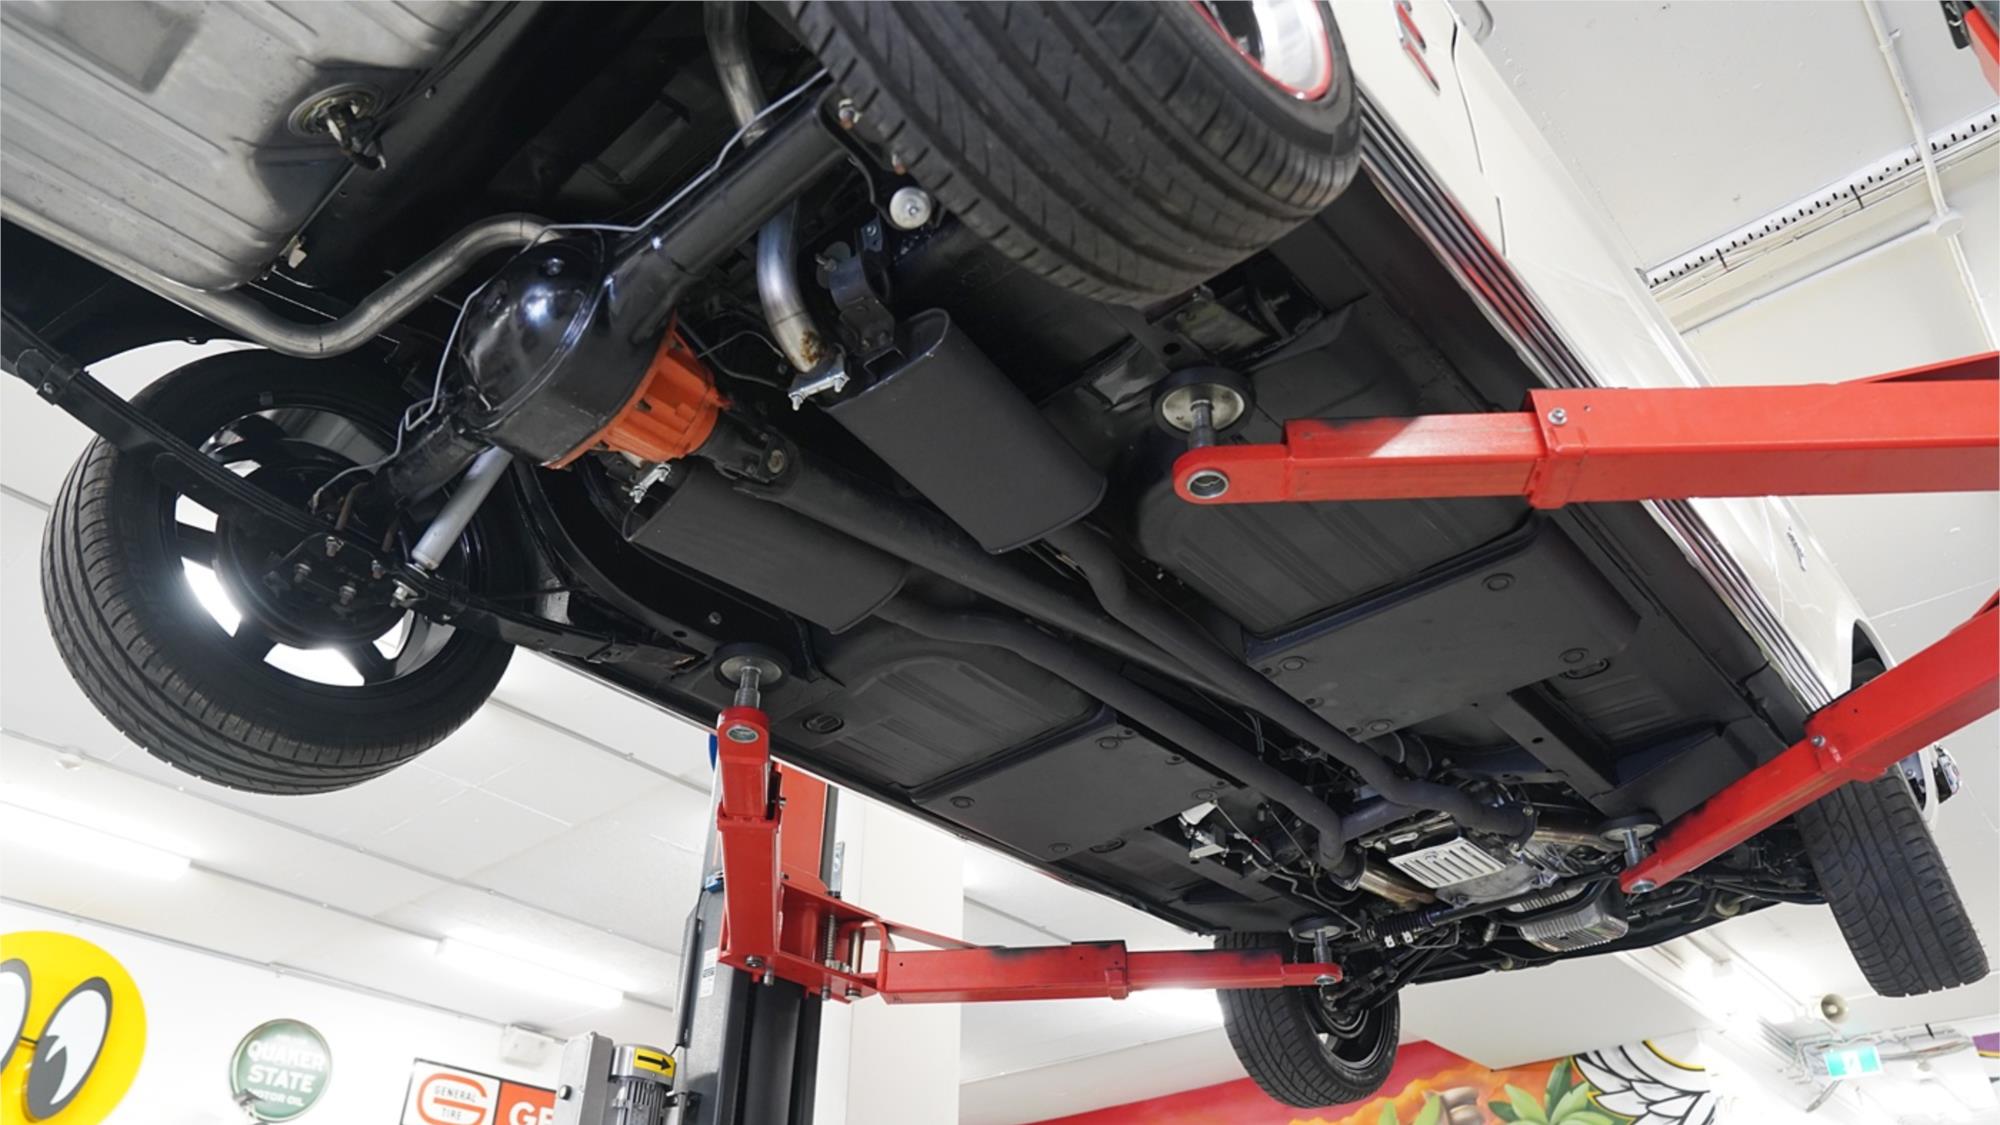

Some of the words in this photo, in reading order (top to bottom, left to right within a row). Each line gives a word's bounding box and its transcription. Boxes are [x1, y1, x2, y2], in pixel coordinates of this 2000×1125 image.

[247, 1040, 326, 1072] QUAKER
[247, 1064, 316, 1094] STATE
[434, 1085, 477, 1103] GENERAL
[441, 1108, 463, 1121] TIRE
